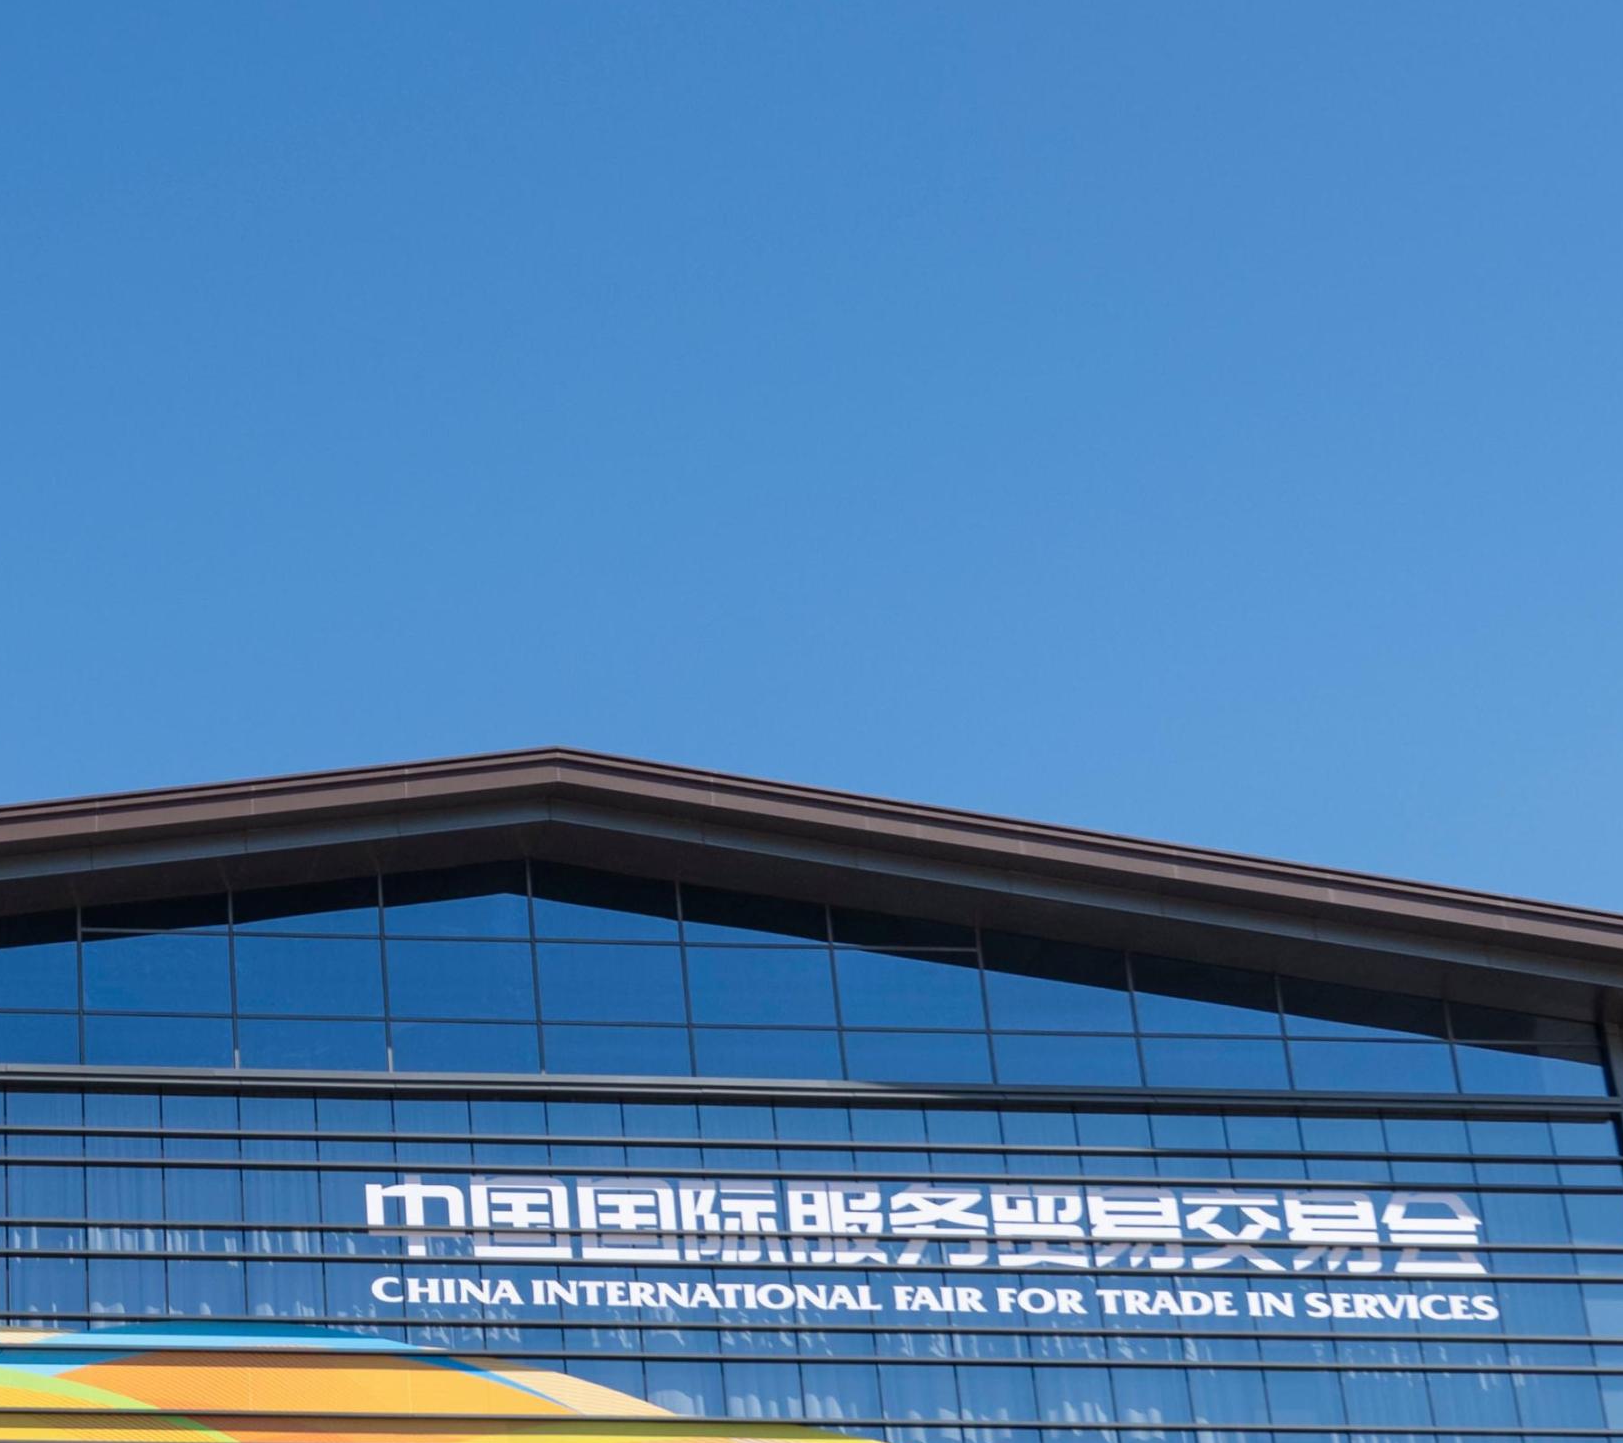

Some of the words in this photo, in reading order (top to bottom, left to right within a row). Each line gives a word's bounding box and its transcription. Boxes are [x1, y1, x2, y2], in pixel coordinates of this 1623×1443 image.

[365, 1174, 1489, 1276] 中国国际服务贸易交易会
[371, 1276, 522, 1306] CHINA
[531, 1278, 883, 1312] INTERNATIONAL
[893, 1286, 988, 1314] FAIR
[996, 1287, 1088, 1315] FOR
[1096, 1288, 1239, 1318] TRADE
[1245, 1290, 1296, 1318] IN
[1304, 1291, 1500, 1322] SERVICES
